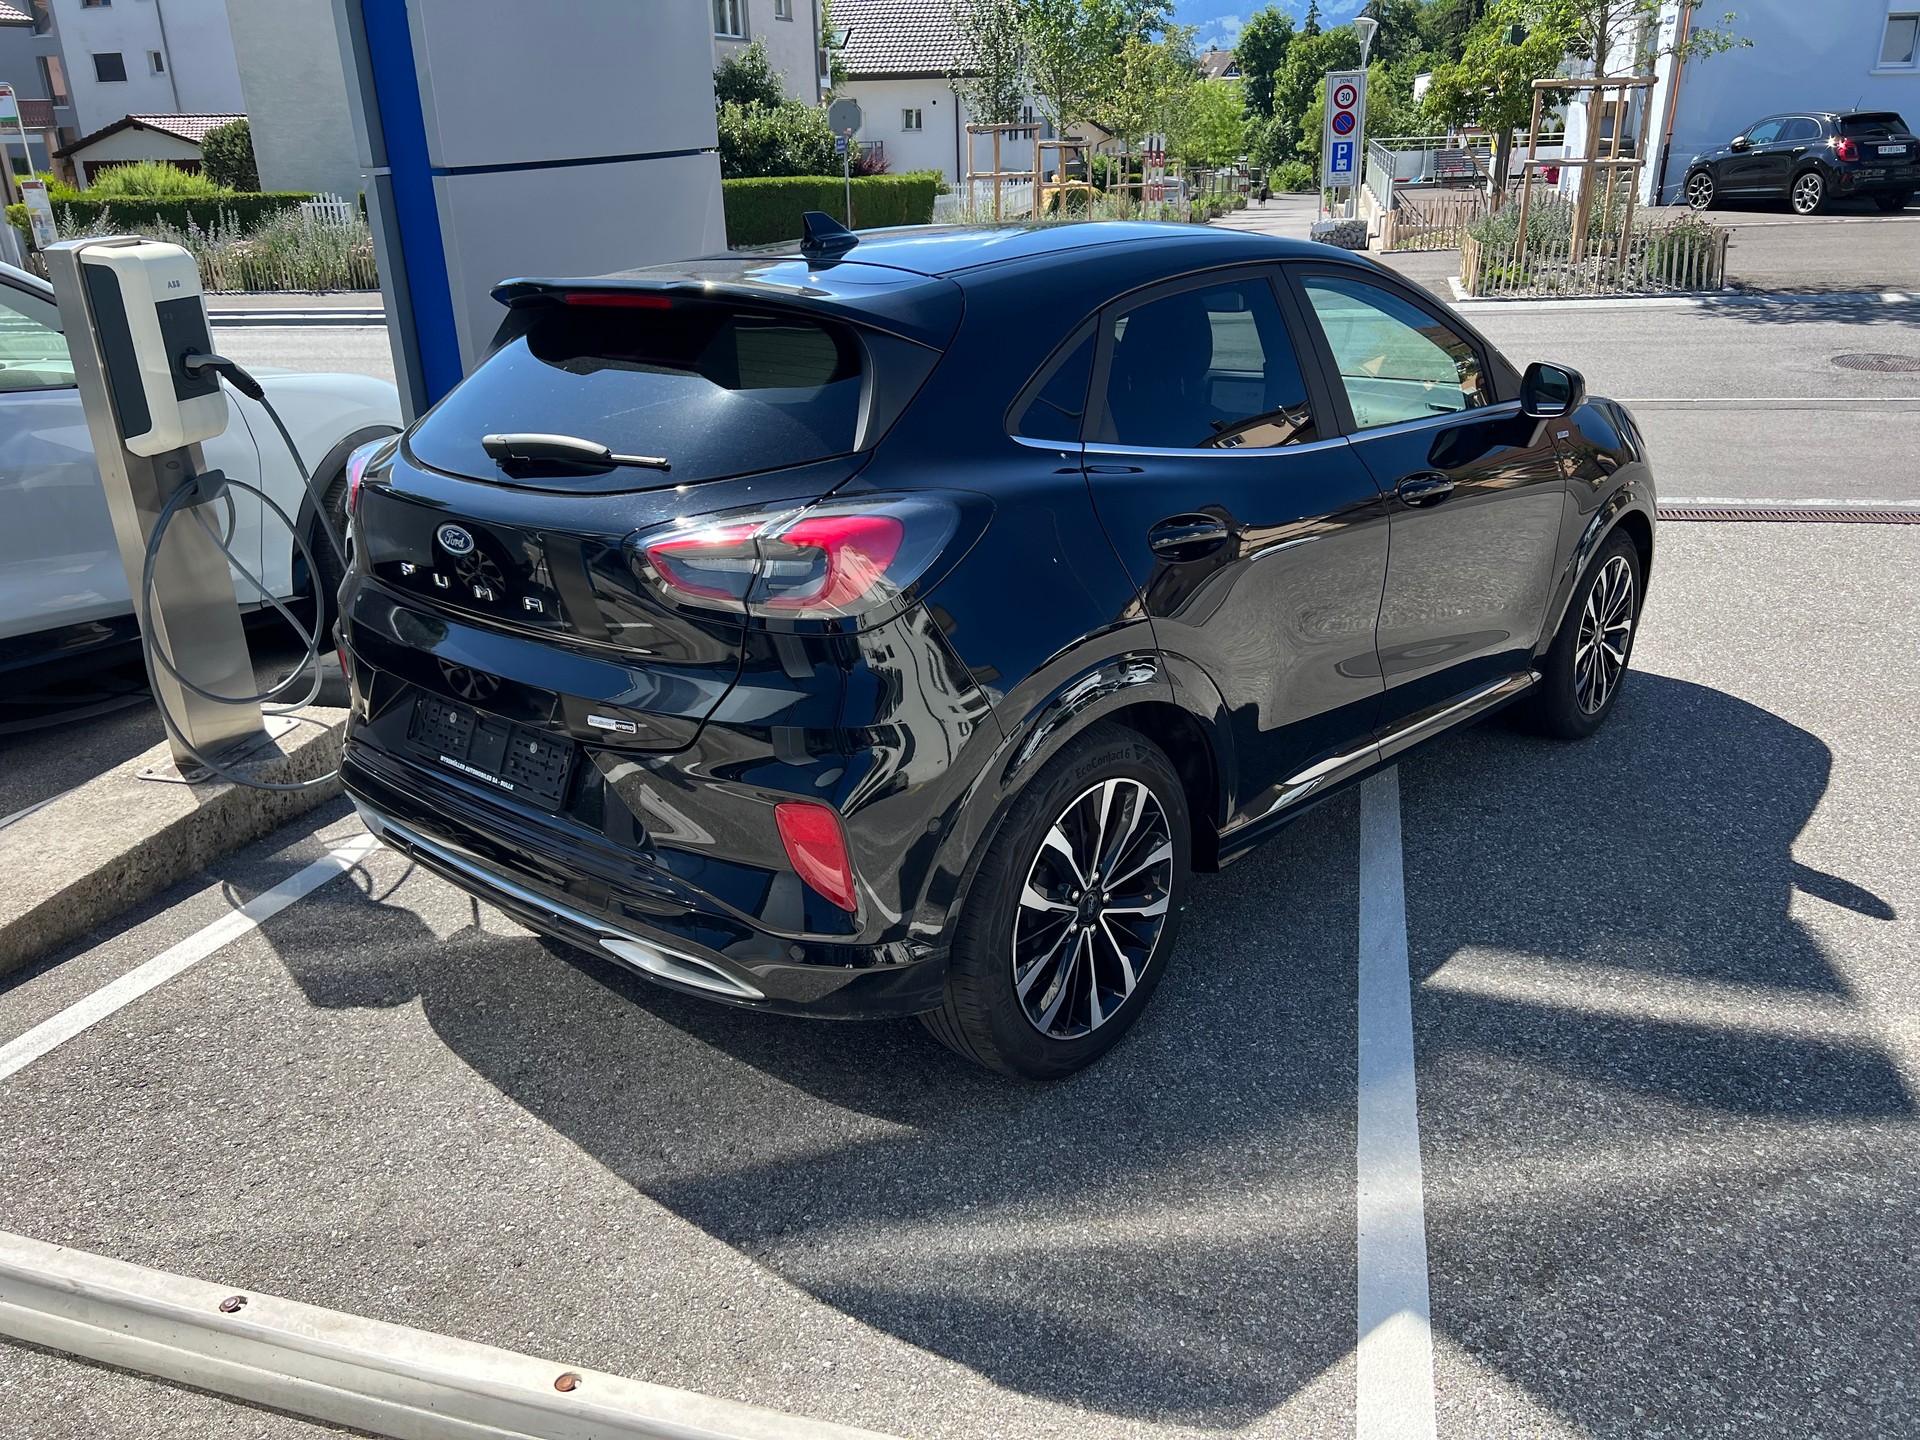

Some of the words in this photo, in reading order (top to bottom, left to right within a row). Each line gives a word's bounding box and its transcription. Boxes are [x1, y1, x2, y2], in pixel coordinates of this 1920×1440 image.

[1341, 92, 1350, 102] 30
[1338, 144, 1347, 159] P
[168, 280, 181, 289] ABB
[444, 529, 465, 548] Ford
[1075, 750, 1124, 780] EcoContact
[1125, 748, 1131, 760] 6
